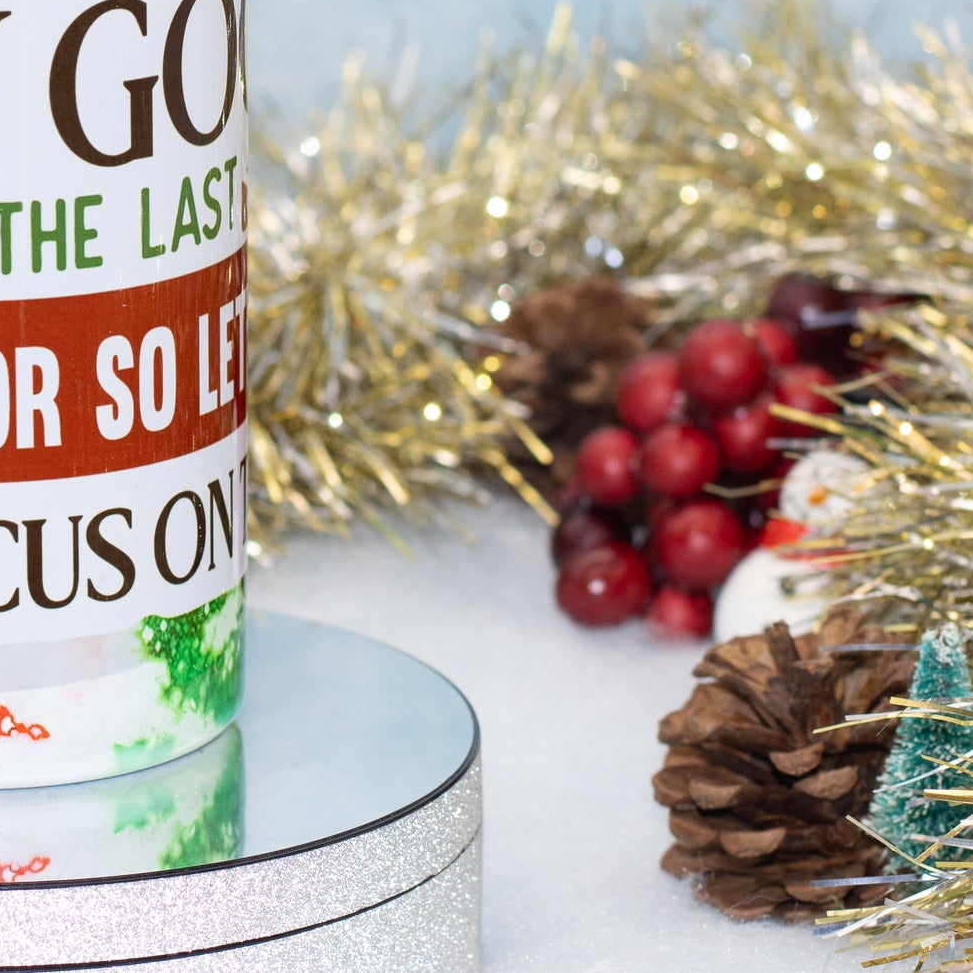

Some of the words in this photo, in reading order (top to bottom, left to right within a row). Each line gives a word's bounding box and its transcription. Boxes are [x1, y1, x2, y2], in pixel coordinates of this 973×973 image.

[140, 155, 238, 259] LAST
[95, 326, 176, 441] SO
[153, 468, 235, 585] ON
